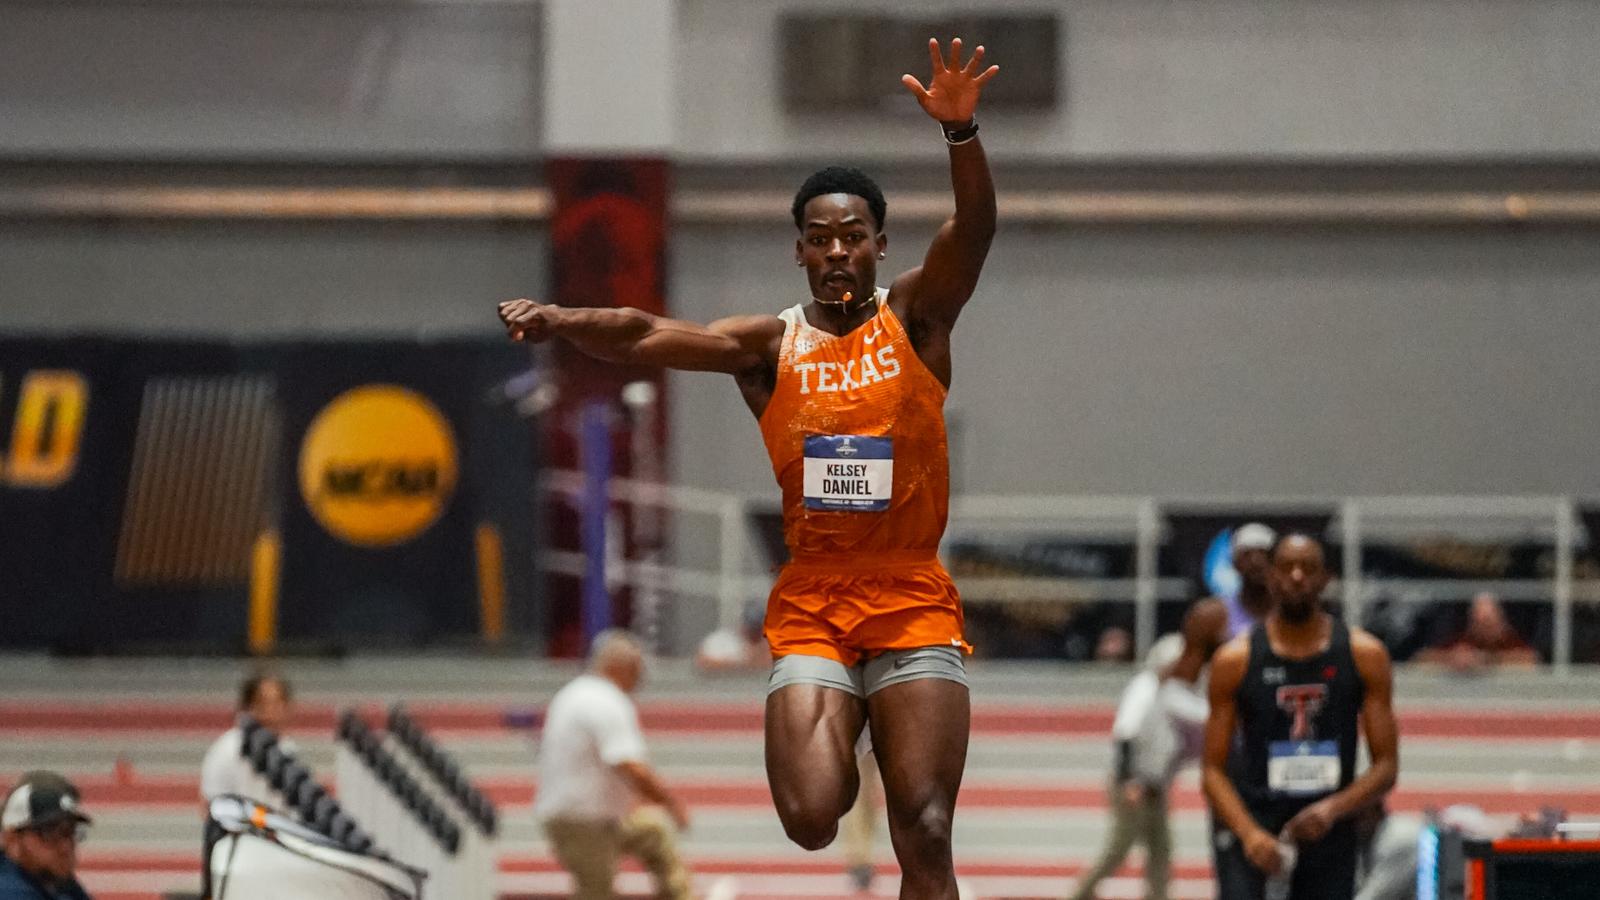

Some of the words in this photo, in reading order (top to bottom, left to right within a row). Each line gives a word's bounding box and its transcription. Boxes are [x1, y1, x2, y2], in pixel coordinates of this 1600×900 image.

[794, 345, 901, 395] TEXAS
[827, 463, 868, 477] KELSEY
[822, 479, 872, 496] DANIEL
